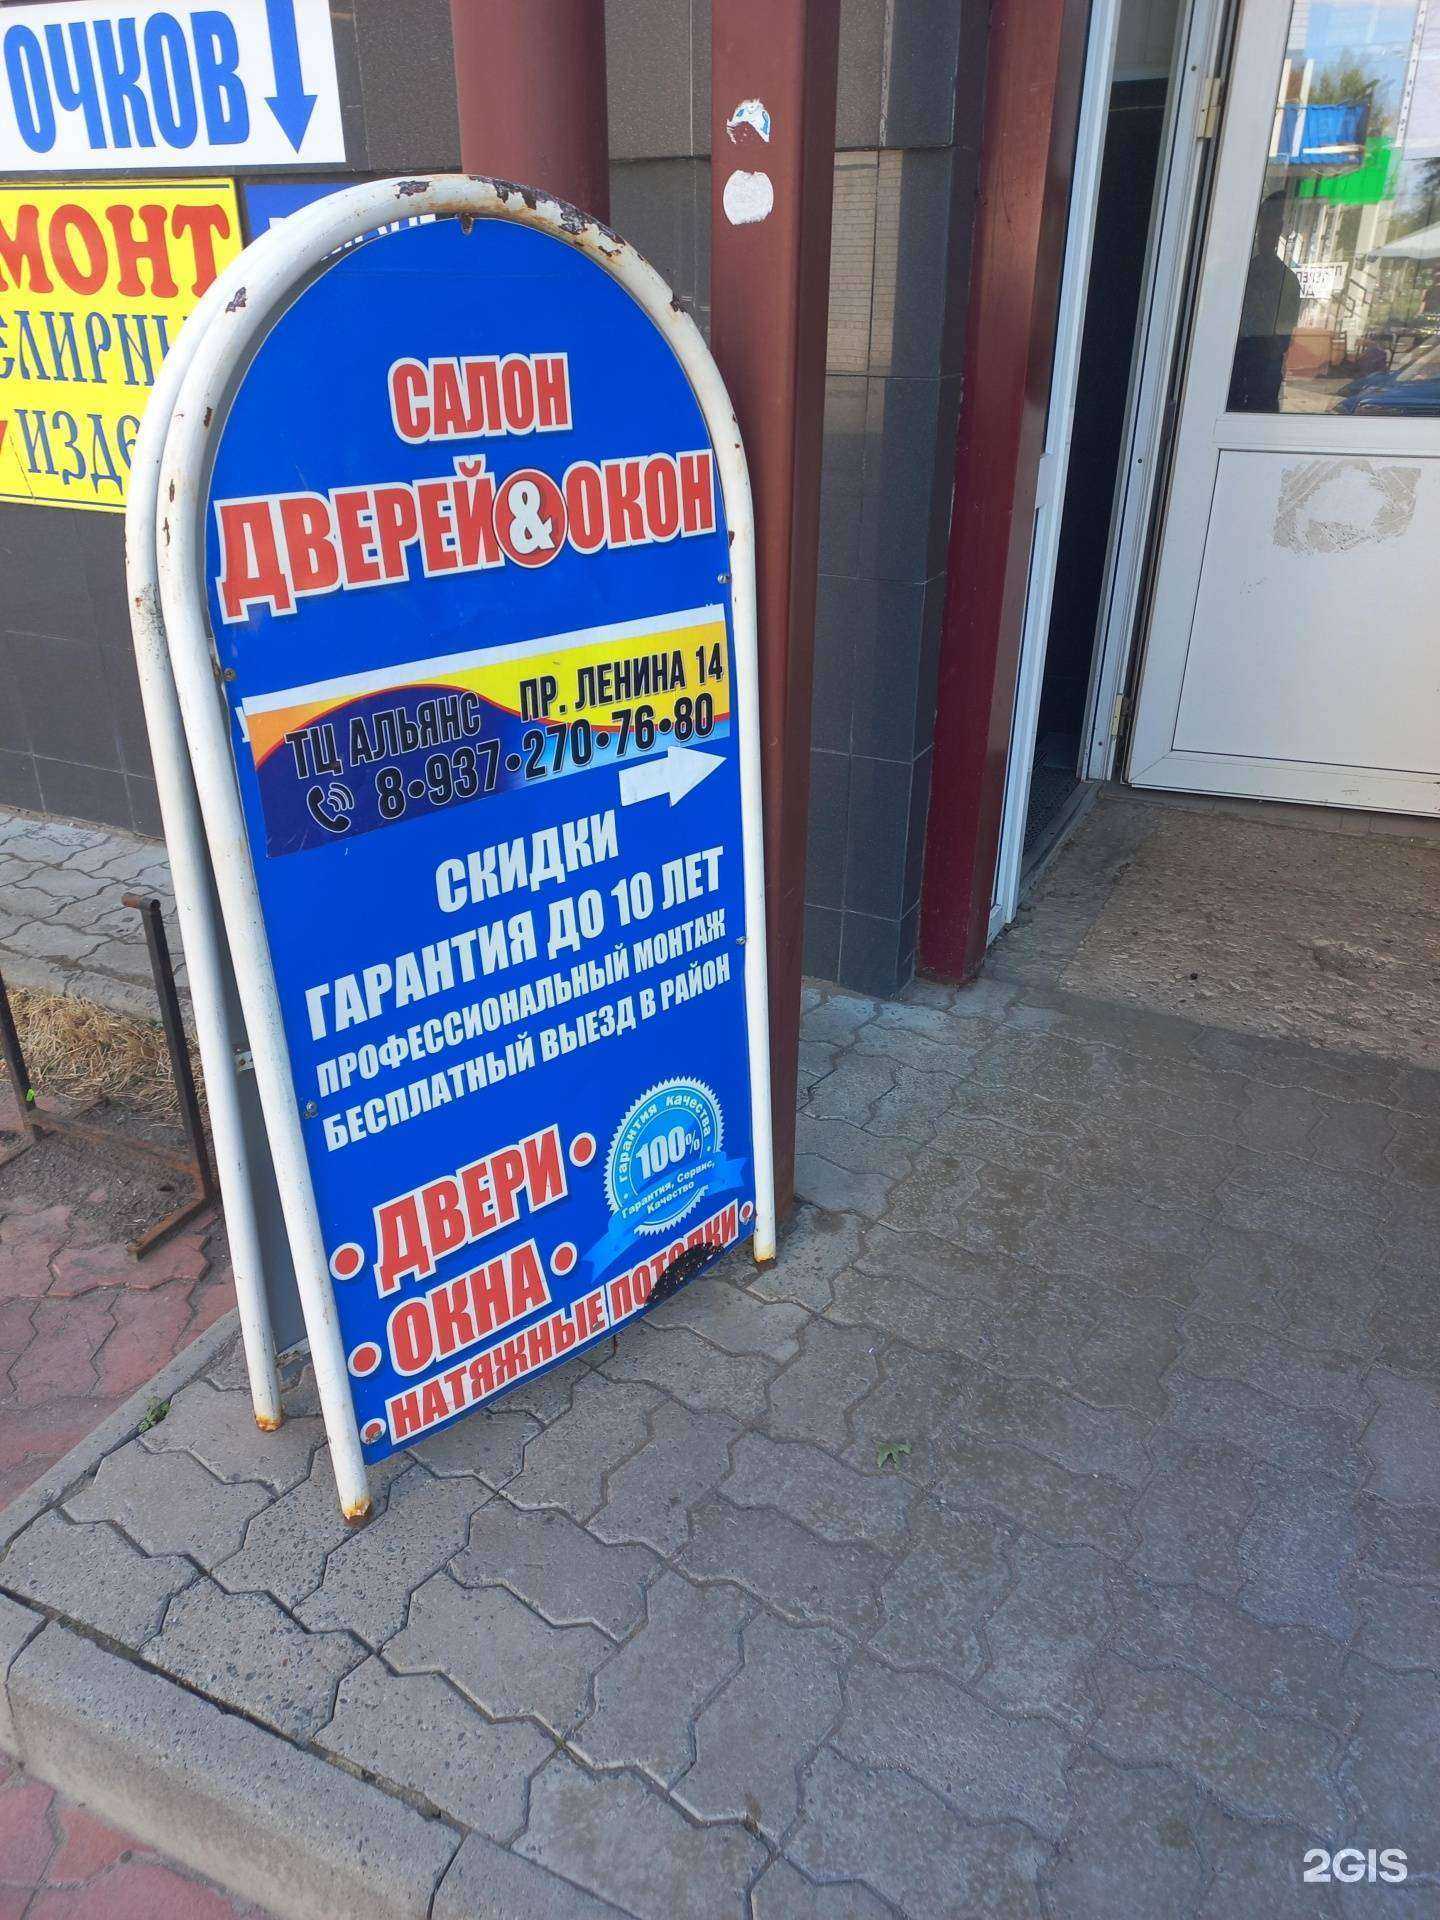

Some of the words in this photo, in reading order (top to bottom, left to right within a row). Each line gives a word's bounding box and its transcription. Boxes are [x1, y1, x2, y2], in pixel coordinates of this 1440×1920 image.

[3, 11, 250, 153] ОЧКОВ
[389, 355, 571, 442] САЛОН
[215, 457, 504, 621] ДВЕРЕЙ
[563, 451, 715, 552] ОКОН
[284, 723, 341, 779] ТЦ
[349, 691, 482, 767] АЛЬЯНС
[519, 674, 567, 722] ПР.
[574, 650, 686, 710] ЛЕНИНА
[695, 642, 724, 685] 14
[435, 809, 619, 914] СКИДКИ
[305, 911, 537, 1041] ГАРАНТИЯ
[547, 889, 604, 959] ДО
[611, 871, 652, 926] 10
[662, 846, 724, 910] ЛЕТ
[316, 943, 629, 1097] ПРОФЕССИОНАЛЬНЫЙ
[633, 909, 727, 973] МОНТАЖ
[322, 1031, 536, 1152] БЕСПЛАТНЫЙ
[540, 998, 636, 1063] ВЫЕЗД
[641, 987, 655, 1021] В
[660, 952, 730, 1011] РАЙОН
[618, 1104, 658, 1182] гарантия
[666, 1095, 711, 1137] качества
[636, 1126, 700, 1179] 100%
[646, 1182, 695, 1214] Качество
[375, 1126, 567, 1296] ДВЕРИ
[388, 1291, 606, 1442] НАТЯЖНЫЕ
[389, 1242, 549, 1374] ОКНА
